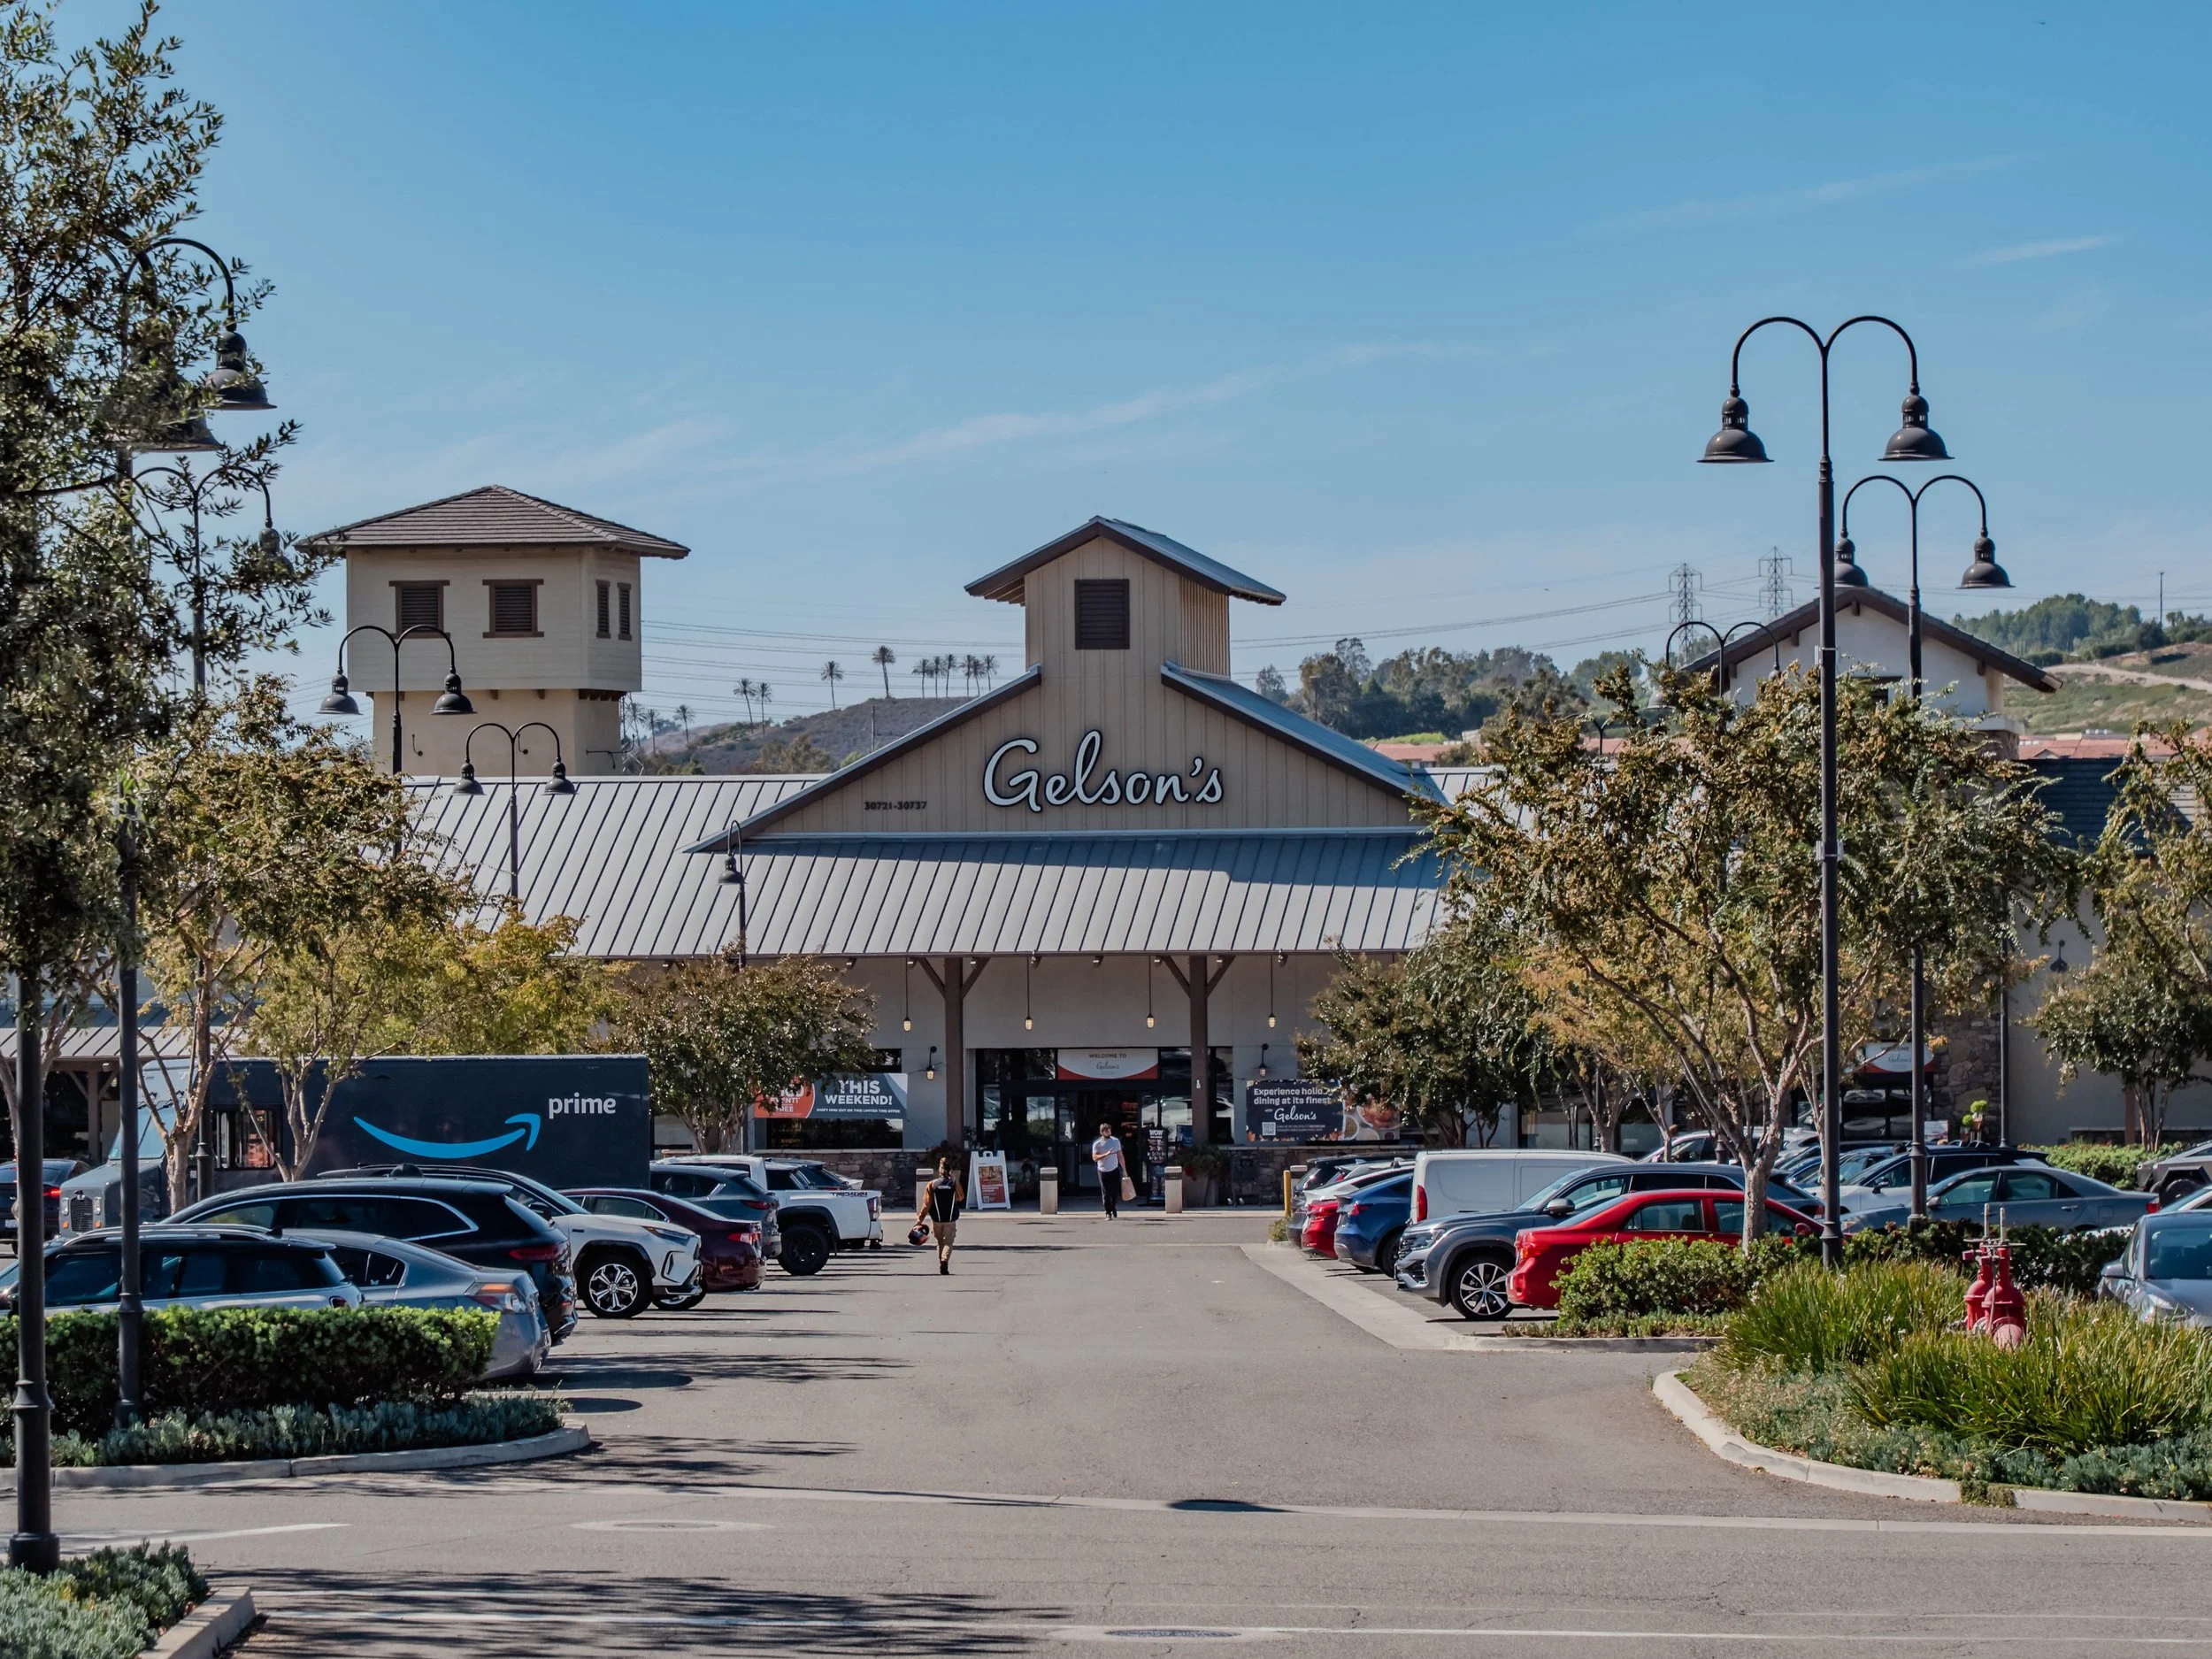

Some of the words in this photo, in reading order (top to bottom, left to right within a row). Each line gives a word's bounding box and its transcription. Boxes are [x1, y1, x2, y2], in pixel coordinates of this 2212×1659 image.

[983, 729, 1224, 812] Gelson's
[838, 1080, 880, 1094] THIS
[1254, 1087, 1300, 1096] Experience
[549, 1092, 617, 1119] prime
[825, 1095, 893, 1105] WEEKEND!
[1254, 1097, 1280, 1106] dining
[1274, 1105, 1317, 1123] Gelson's
